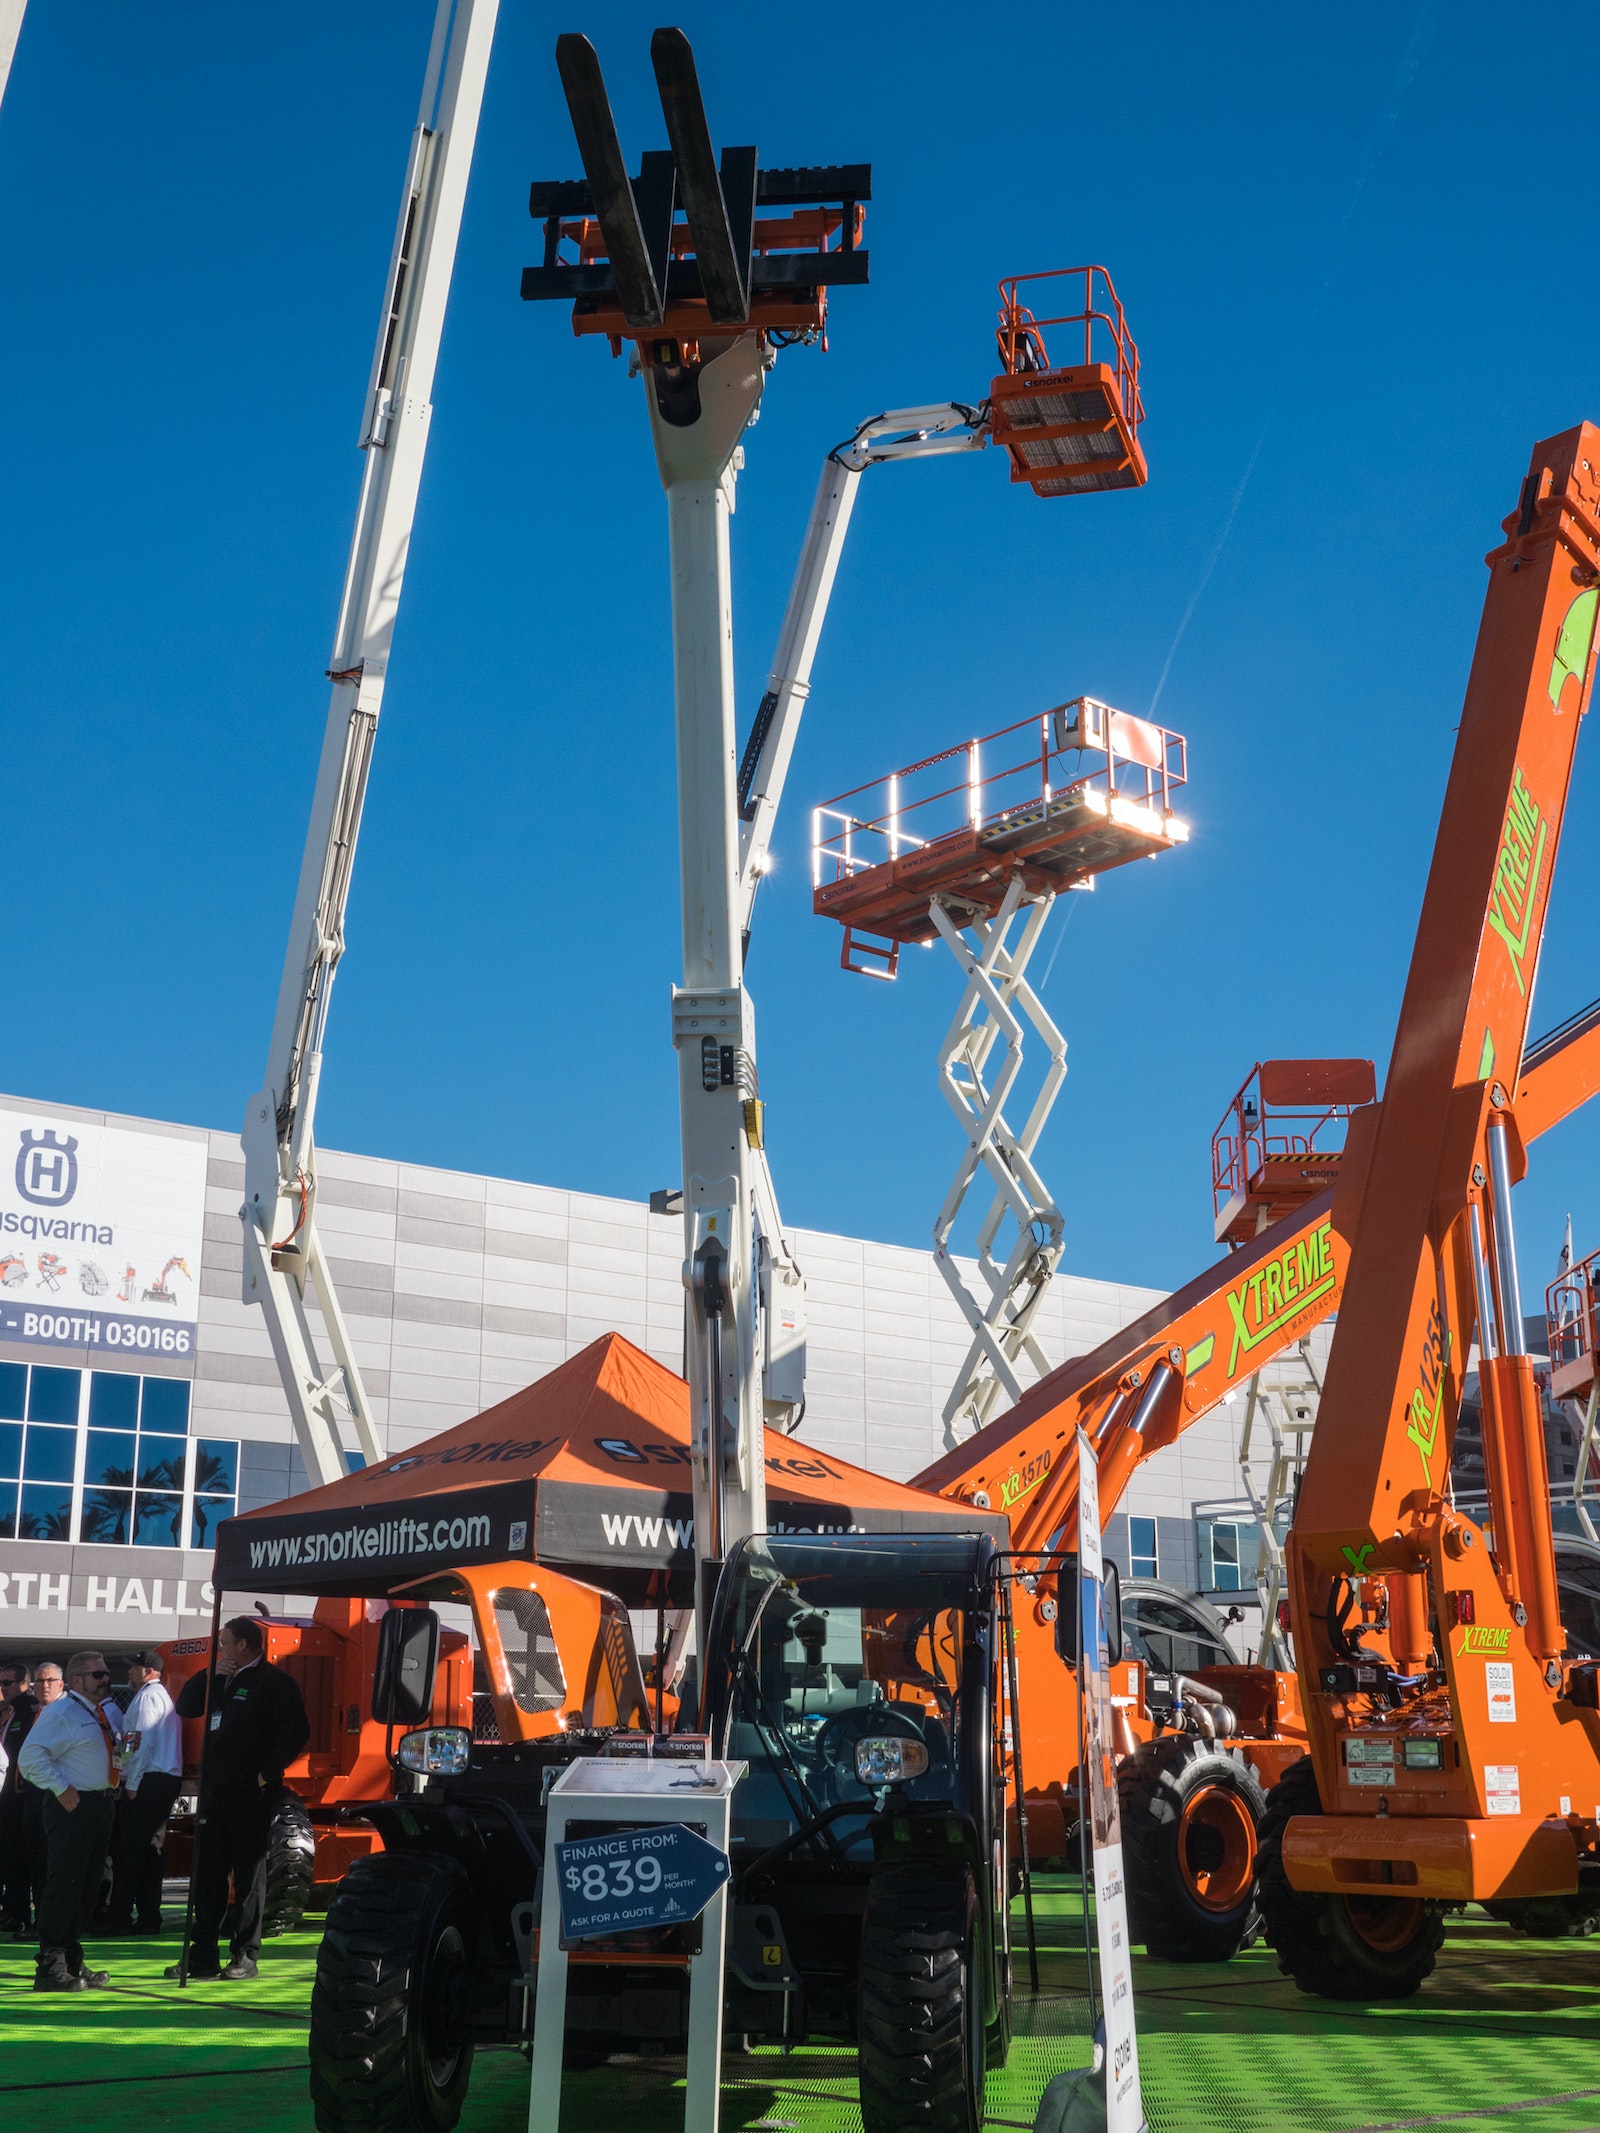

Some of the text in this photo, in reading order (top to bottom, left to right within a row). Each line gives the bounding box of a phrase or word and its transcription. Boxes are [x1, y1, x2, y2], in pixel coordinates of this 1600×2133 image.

[1032, 375, 1074, 387] snorkel
[828, 882, 858, 900] snorkel
[1487, 765, 1547, 998] XTREME
[1309, 1169, 1340, 1178] snork
[0, 1211, 113, 1245] sqvarna
[1226, 1221, 1336, 1379] XTREME
[23, 1312, 99, 1343] BOOTH
[105, 1321, 190, 1352] 030166
[250, 1515, 491, 1569] www.snorkellifts.com
[86, 1575, 223, 1618] HALLS
[1456, 1626, 1512, 1658] XTREME
[617, 1741, 646, 1750] snorkel
[675, 1743, 704, 1751] snorkel
[562, 1833, 678, 1863] FINANCE FROM:
[565, 1855, 662, 1901] $839
[663, 1872, 680, 1882] PER
[570, 1906, 655, 1927] ASK FOR A QUOTE
